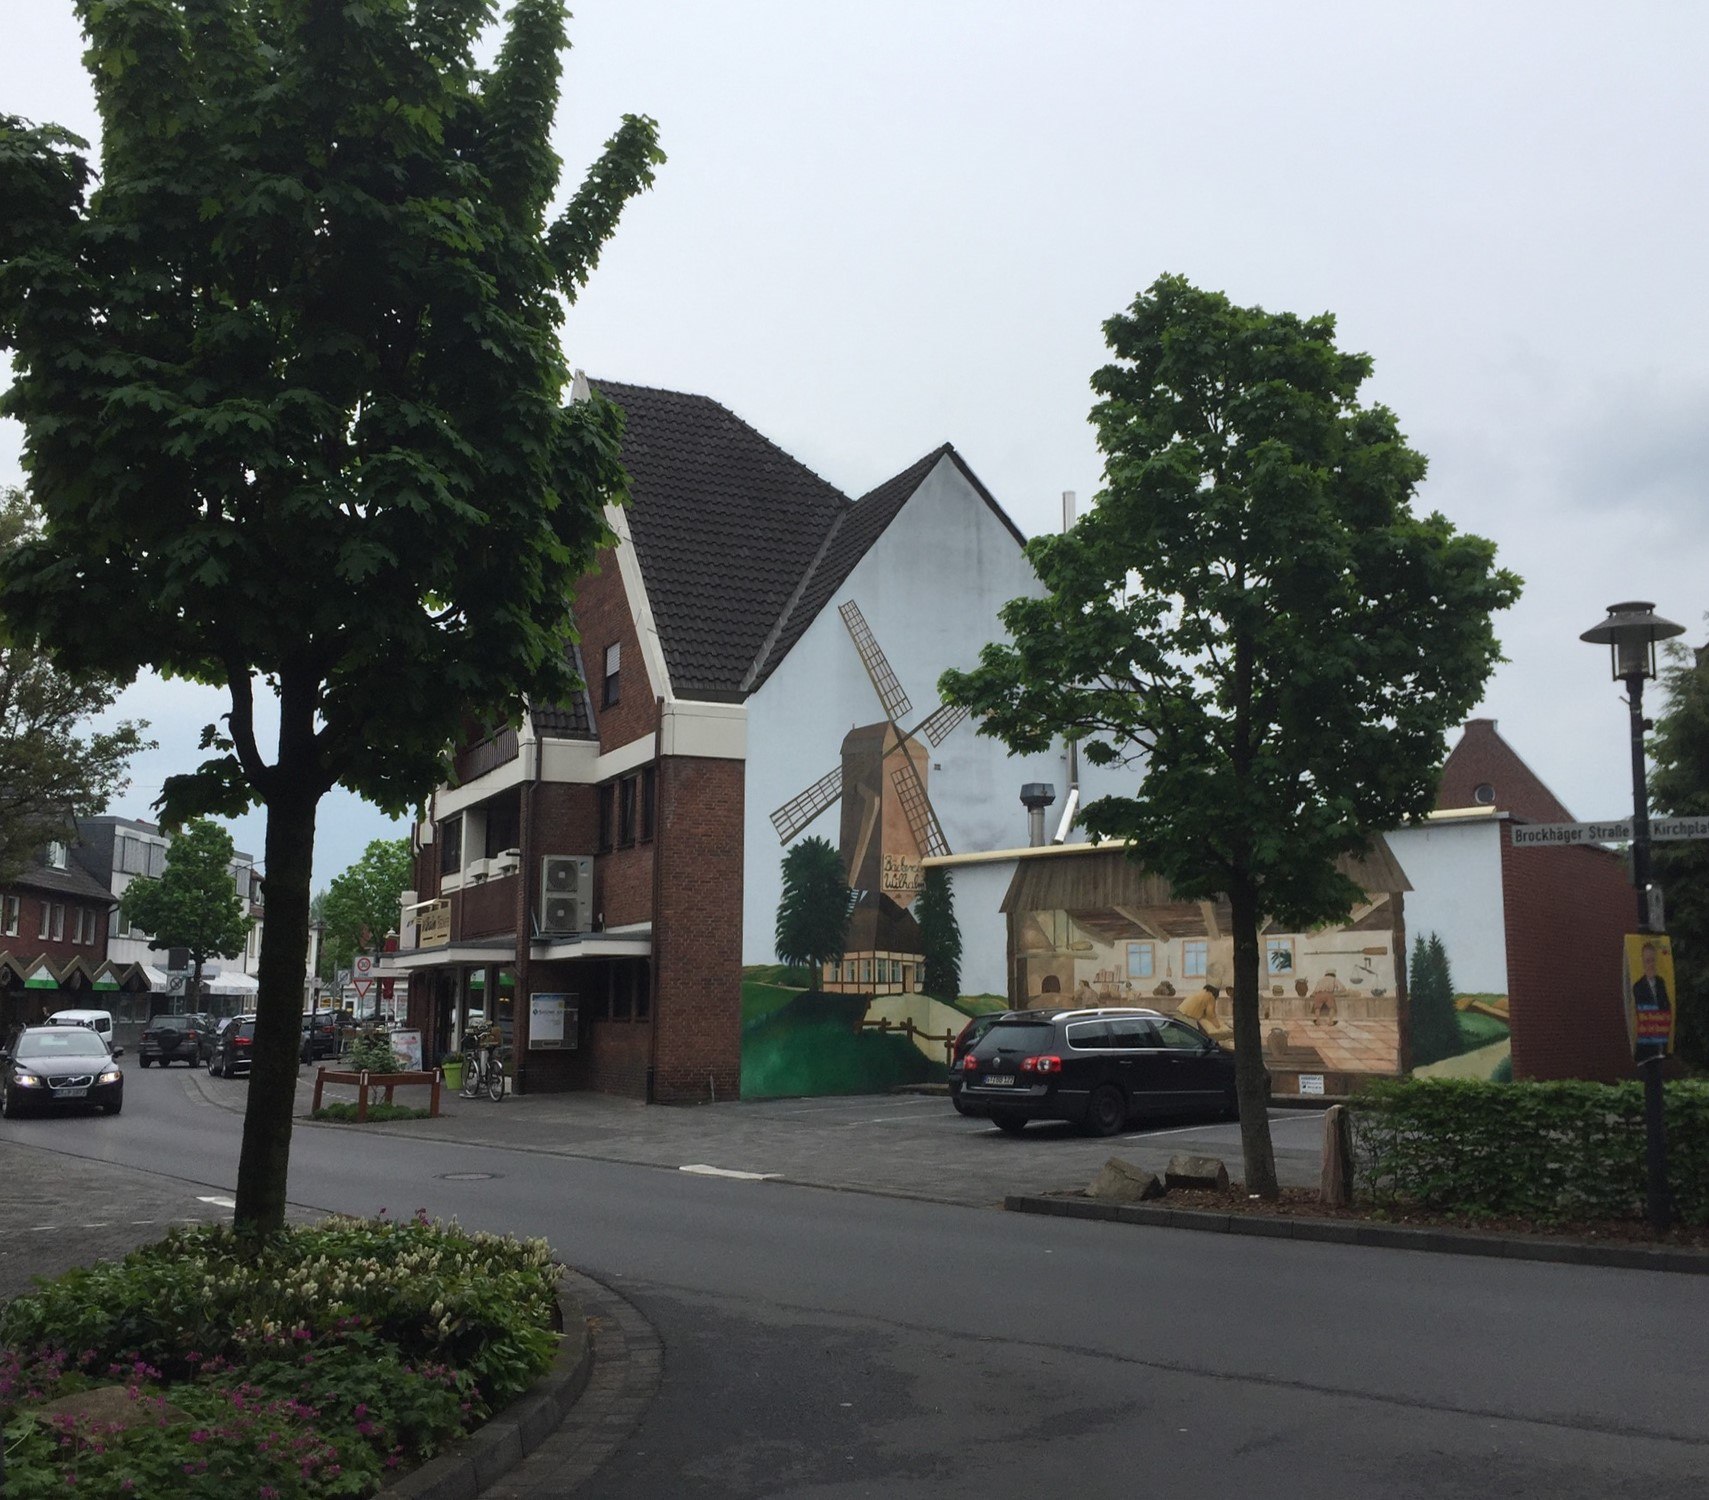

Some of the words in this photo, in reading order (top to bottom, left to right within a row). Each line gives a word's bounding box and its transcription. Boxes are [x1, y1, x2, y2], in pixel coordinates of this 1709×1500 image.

[1515, 827, 1583, 843] Brockhäger
[1589, 825, 1629, 839] Straße
[1654, 821, 1709, 837] Kirchpla
